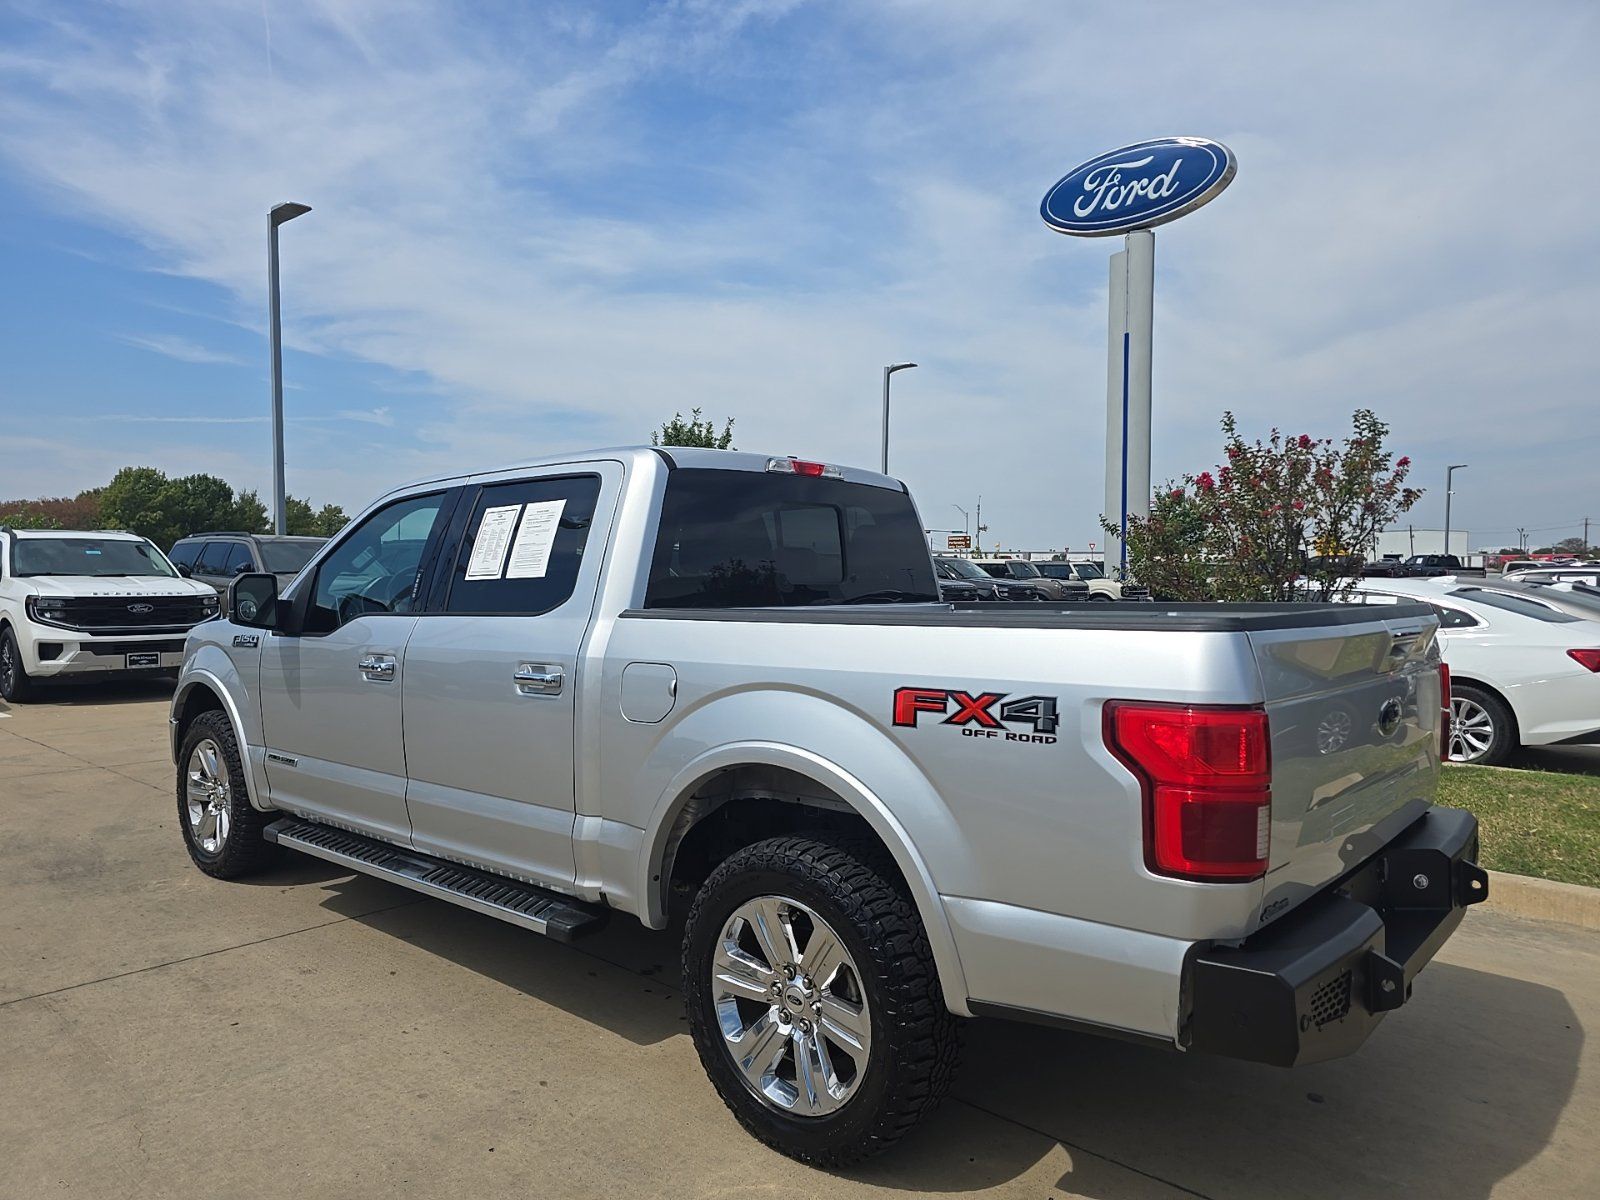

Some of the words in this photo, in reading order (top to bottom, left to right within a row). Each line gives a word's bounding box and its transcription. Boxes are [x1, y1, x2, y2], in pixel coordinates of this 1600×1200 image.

[1073, 156, 1183, 218] Ford
[892, 687, 1060, 735] FX4
[961, 728, 999, 739] OFF
[1005, 732, 1058, 745] ROAD
